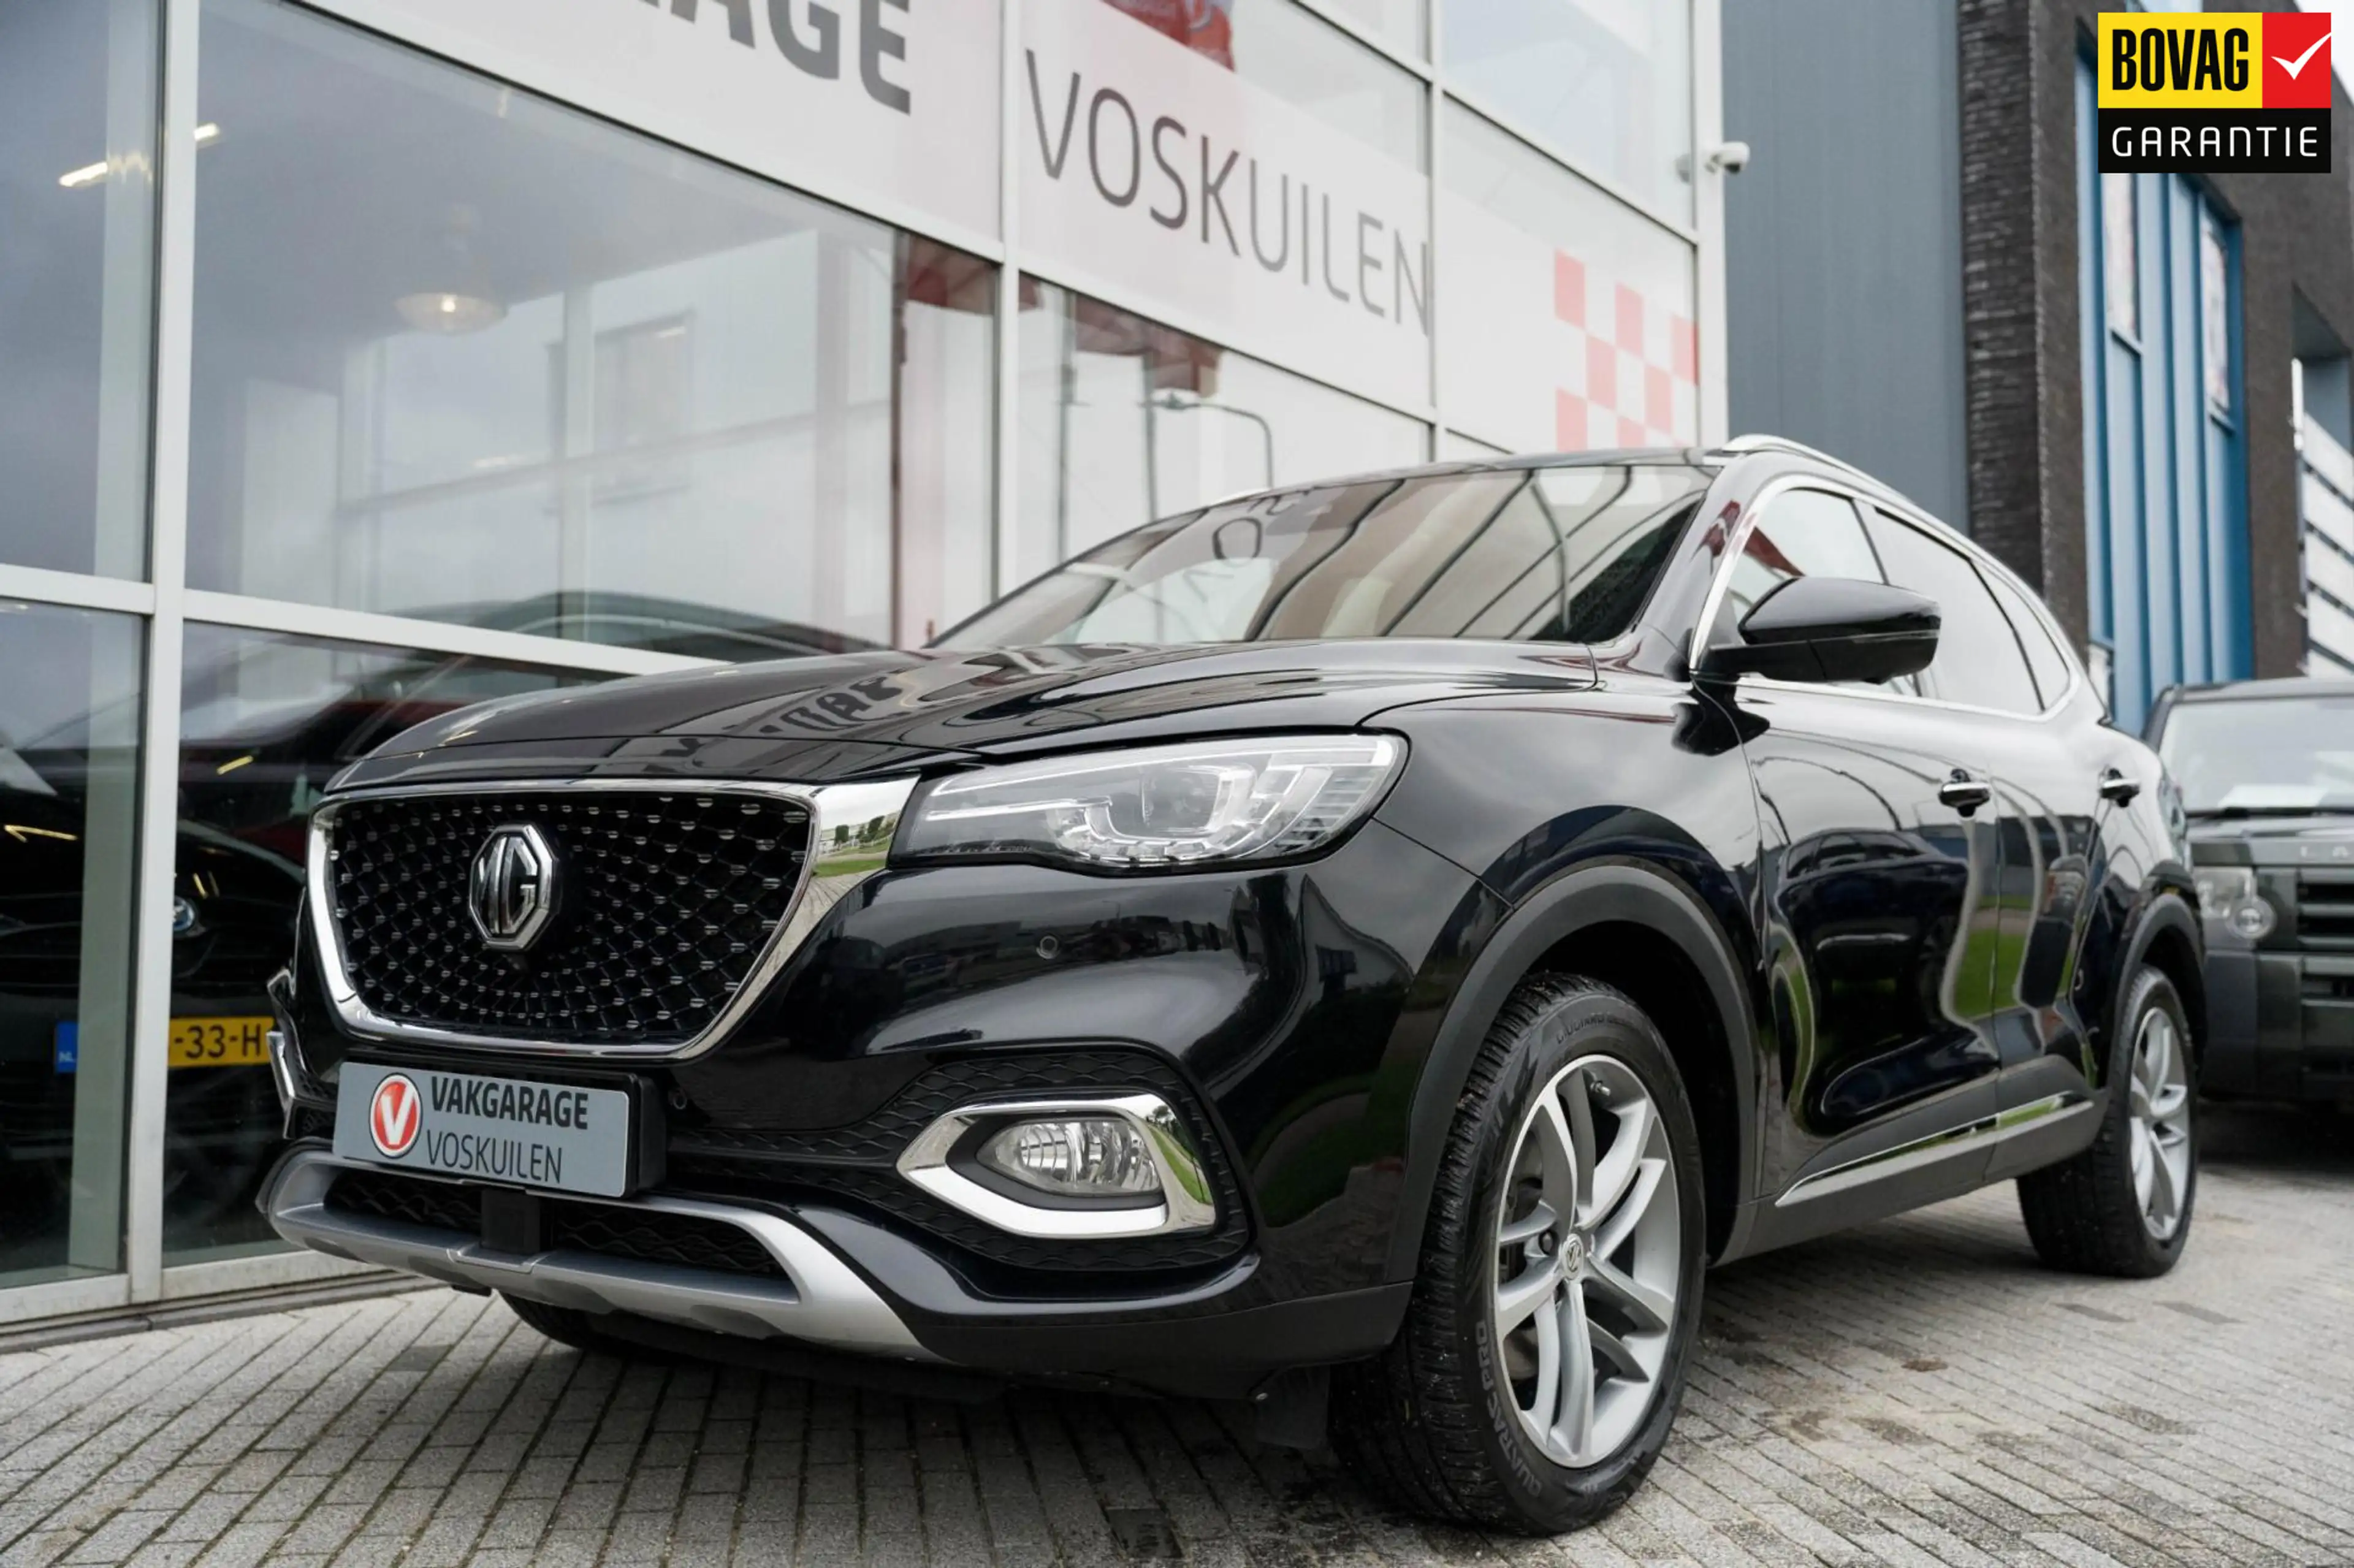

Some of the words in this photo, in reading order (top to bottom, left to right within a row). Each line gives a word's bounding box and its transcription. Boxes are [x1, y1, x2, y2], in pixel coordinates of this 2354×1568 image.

[639, 0, 910, 116] GE
[1026, 48, 1428, 338] VOSKUILEN
[478, 836, 538, 934] MG
[431, 1076, 588, 1130] VAKGARAGE
[427, 1130, 562, 1184] VOSKUILEN
[1476, 1320, 1494, 1391] PRO
